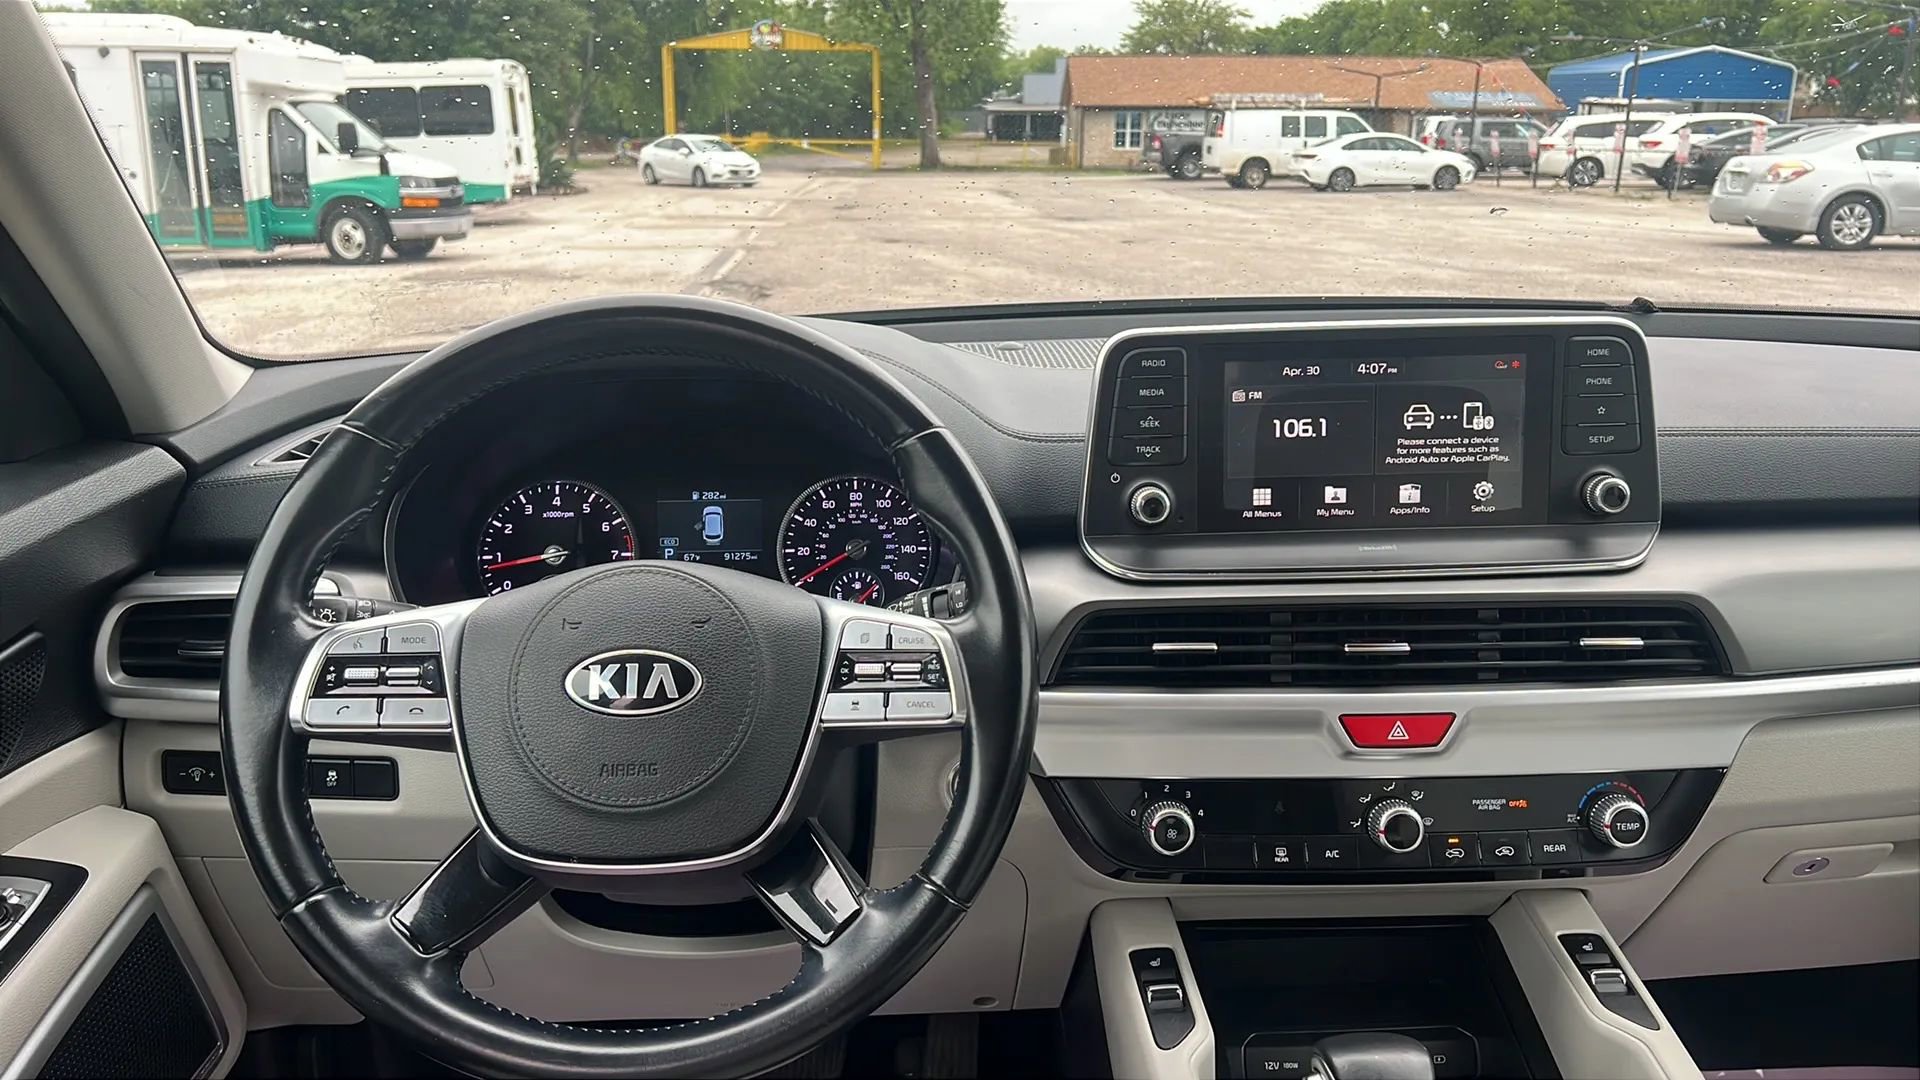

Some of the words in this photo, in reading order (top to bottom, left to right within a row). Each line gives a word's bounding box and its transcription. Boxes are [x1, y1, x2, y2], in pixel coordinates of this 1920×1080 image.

[1587, 348, 1610, 356] HOME
[1282, 366, 1304, 377] Apr.
[1306, 366, 1320, 375] 30
[1357, 363, 1387, 375] 4:07
[1586, 377, 1612, 385] PHONE
[1139, 388, 1164, 396] MEDIA
[1248, 391, 1262, 399] FM
[1140, 420, 1160, 428] SEEK
[1273, 418, 1327, 438] 106.1
[1397, 438, 1425, 446] Please
[1426, 437, 1461, 445] connect
[1470, 436, 1499, 444] device
[1397, 447, 1408, 455] for
[1468, 445, 1488, 453] such
[1385, 456, 1418, 464] Android
[1450, 455, 1475, 463] Apple
[1476, 454, 1510, 463] CarPlay.
[849, 492, 863, 500] 80
[552, 496, 561, 507] 4
[822, 500, 835, 509] 60
[876, 500, 891, 508] 100
[524, 505, 533, 515] 3
[582, 504, 591, 514] 5
[1316, 509, 1329, 517] My
[1331, 508, 1354, 516] Menu
[1390, 506, 1430, 515] Apps/Info
[1471, 505, 1496, 513] Setup
[542, 511, 574, 519] x1000rpm
[1242, 510, 1253, 518] All
[1254, 510, 1282, 518] Menus
[804, 519, 817, 527] 40
[893, 517, 908, 525] 120
[504, 524, 513, 534] 2
[601, 522, 610, 532] 6
[664, 548, 673, 559] P
[797, 547, 810, 556] 20
[901, 545, 916, 553] 140
[496, 552, 501, 563] 1
[610, 550, 619, 560] 7
[894, 572, 910, 580] 160
[503, 581, 512, 590] 0
[837, 592, 842, 600] E
[401, 636, 426, 644] MODE
[588, 663, 679, 700] KIA
[600, 762, 658, 778] AIRBAG
[1185, 791, 1191, 799] 3
[1543, 844, 1567, 852] REAR
[1325, 850, 1339, 858] A/C
[1264, 1061, 1280, 1070] 12V
